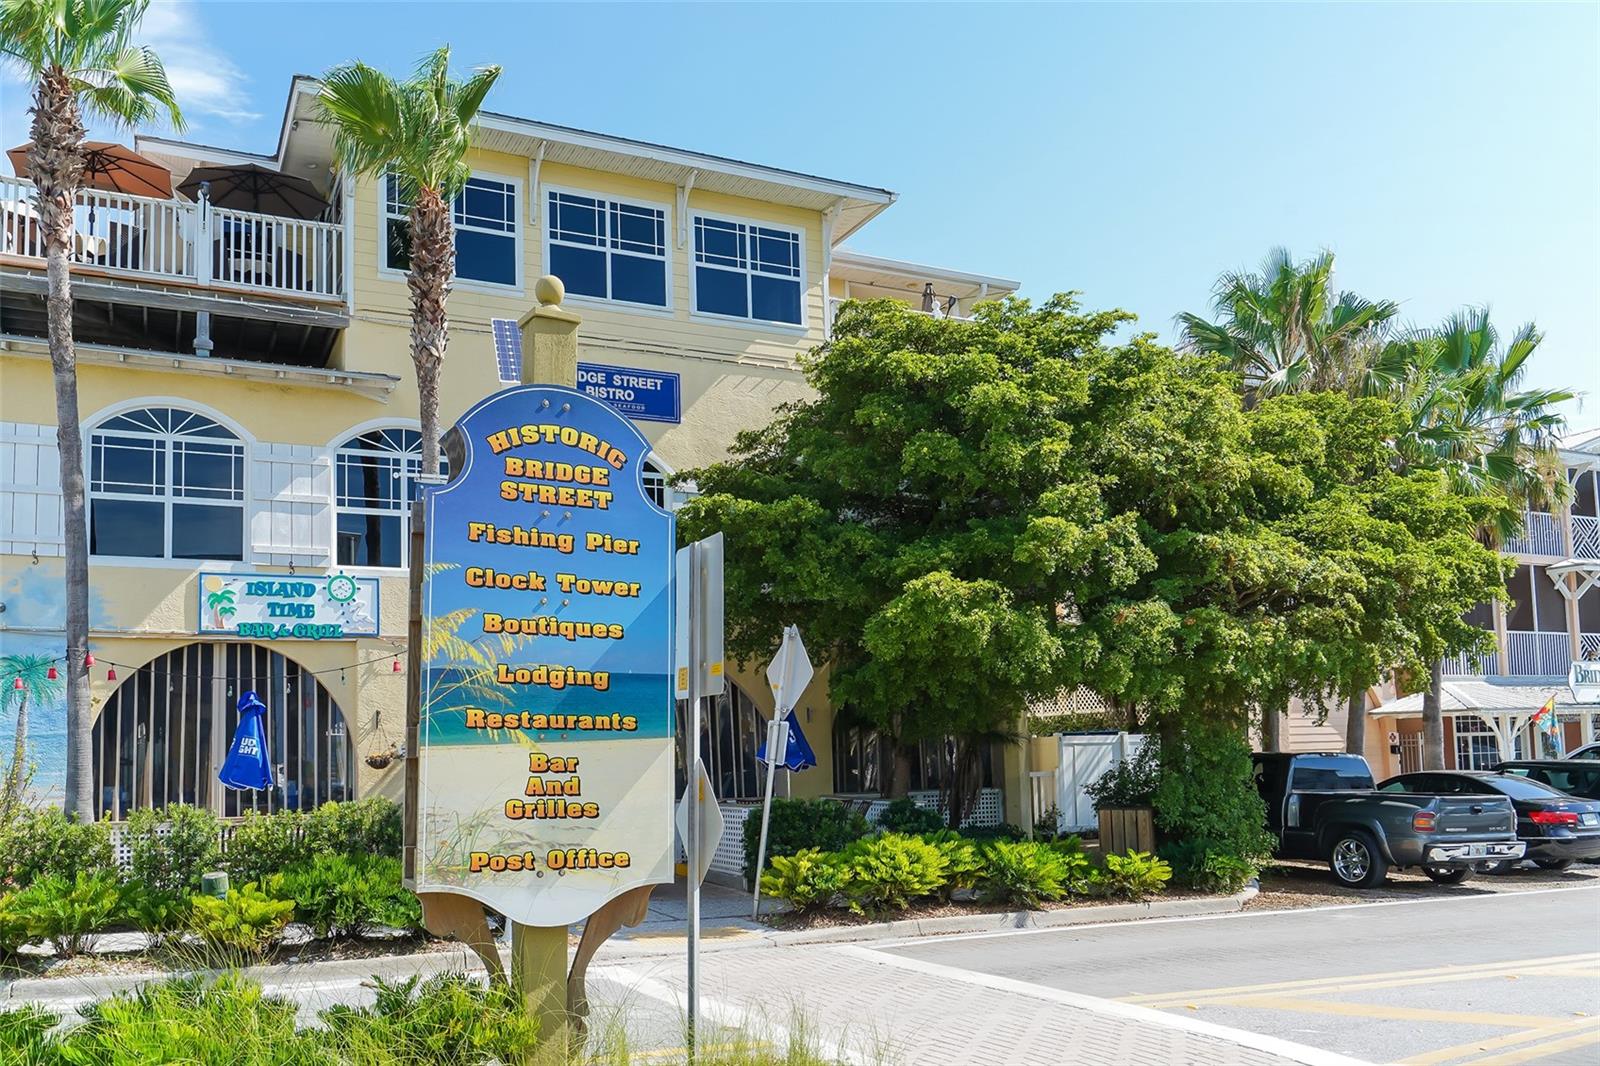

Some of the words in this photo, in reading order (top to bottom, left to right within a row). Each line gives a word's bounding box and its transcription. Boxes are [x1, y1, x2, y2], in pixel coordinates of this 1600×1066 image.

[578, 370, 606, 385] DGE
[613, 374, 663, 391] STREET
[586, 385, 635, 401] BISTRO
[486, 424, 628, 471] HISTORIC
[505, 456, 610, 486] BRIDGE
[500, 481, 613, 510] STREET
[468, 521, 575, 554] Fishing
[585, 531, 640, 555] Pier
[246, 581, 316, 598] ISLAND
[465, 567, 546, 592] Clock
[556, 572, 641, 598] Tower
[267, 602, 315, 619] TIME
[237, 622, 277, 640] BAR
[275, 624, 291, 638] &
[292, 623, 344, 640] GRILL
[483, 613, 624, 642] Boutiques
[497, 663, 610, 691] Lodging
[465, 707, 638, 731] Restaurants
[241, 737, 257, 747] UD
[529, 752, 579, 773] Bar
[525, 776, 581, 797] And
[505, 799, 600, 820] Grilles
[469, 851, 535, 873] Post
[546, 848, 631, 870] Office
